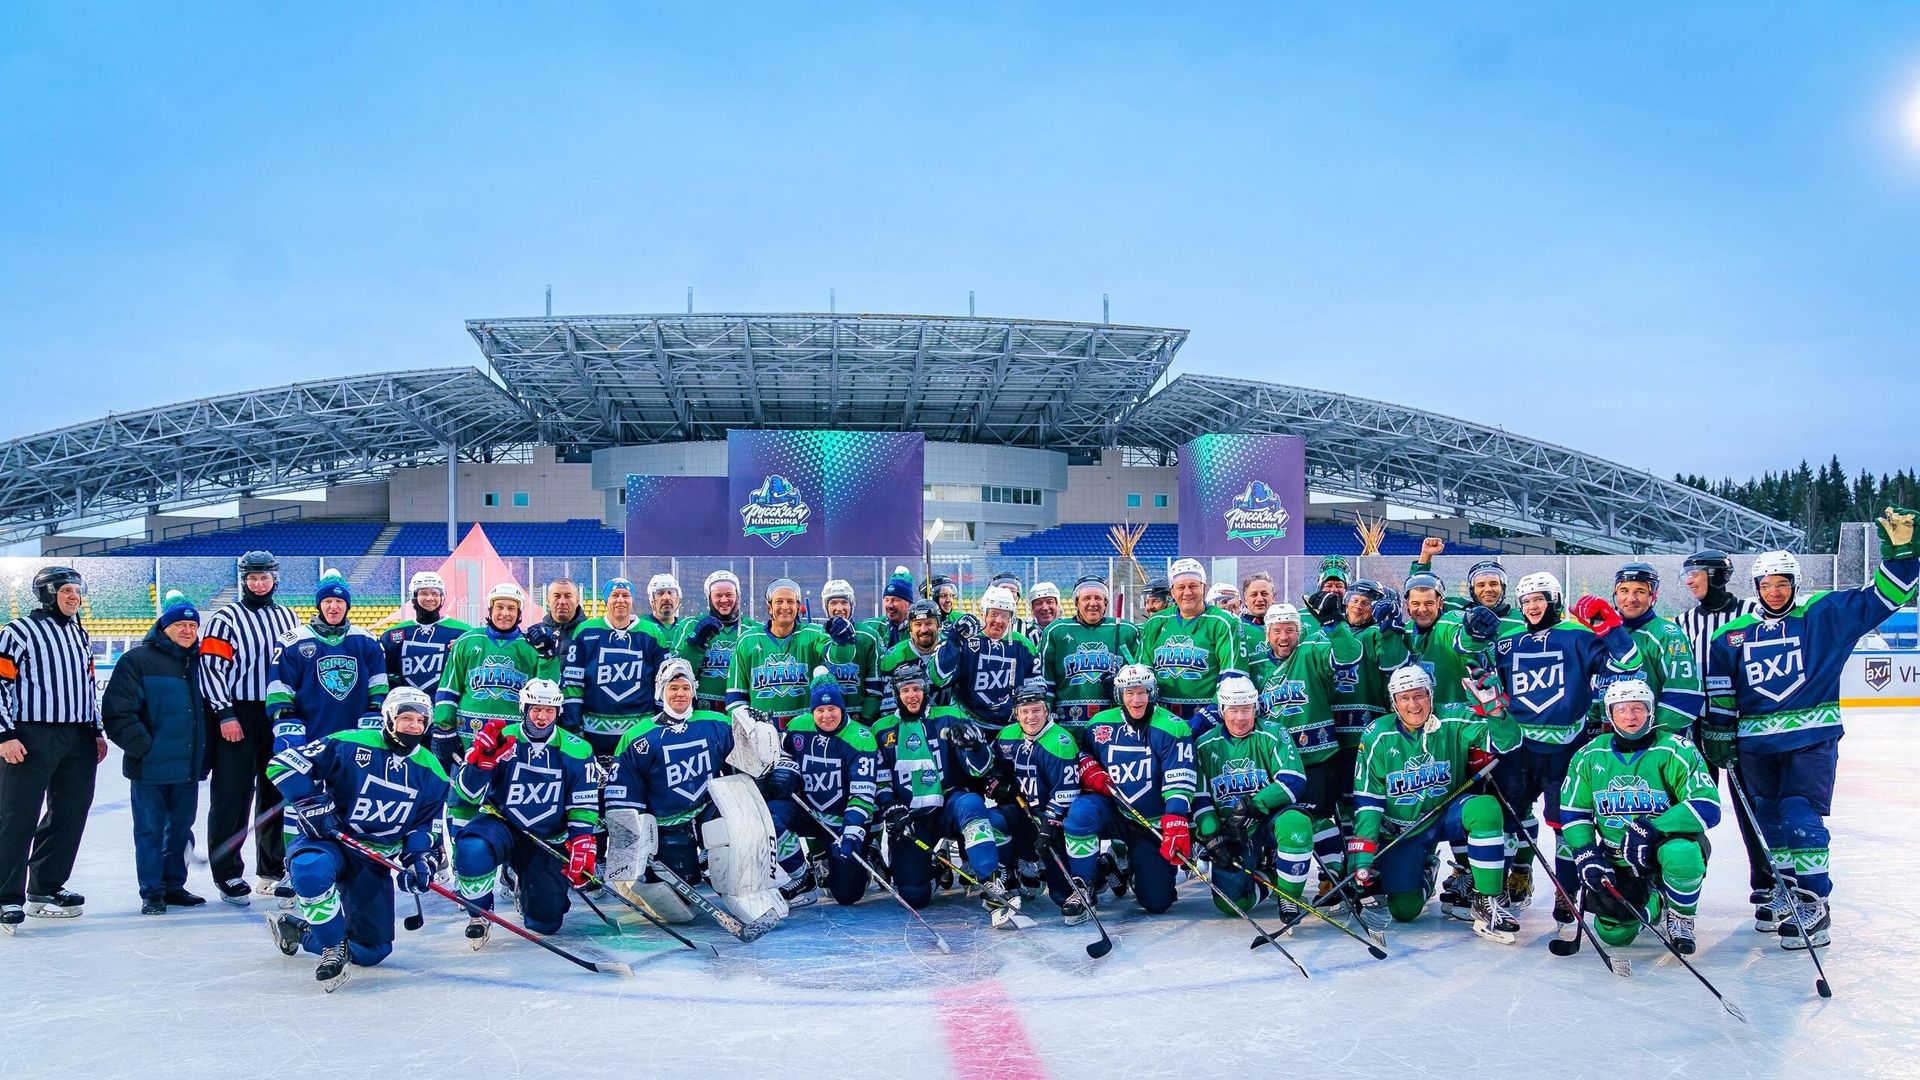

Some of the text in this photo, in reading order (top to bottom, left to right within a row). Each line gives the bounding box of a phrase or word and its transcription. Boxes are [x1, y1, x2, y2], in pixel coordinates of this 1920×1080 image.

[566, 645, 576, 662] 8
[1153, 648, 1208, 671] ГЛАВК
[401, 654, 444, 676] ВХЛ
[597, 660, 643, 685] ВХЛ
[1033, 659, 1041, 674] 2
[1671, 660, 1692, 679] 13
[1746, 649, 1803, 686] ВХЛ
[1866, 664, 1890, 681] ВХЛ
[468, 666, 528, 692] ГЛАВК
[751, 664, 809, 689] ГЛАВК
[974, 669, 1012, 691] ВХЛ
[1512, 664, 1564, 696] ВХЛ
[279, 724, 303, 734] STX
[361, 719, 384, 727] STX
[355, 753, 372, 762] ВХЛ
[1176, 742, 1194, 763] 14
[666, 751, 712, 788] ВХЛ
[857, 756, 875, 776] 31
[1063, 765, 1080, 784] 25
[1108, 759, 1152, 784] ВХЛ
[803, 771, 843, 793] ВХЛ
[1016, 777, 1038, 796] ХЛ
[1388, 761, 1451, 797] ГЛАВК
[506, 781, 562, 806] ВХЛ
[1594, 790, 1669, 815] ГЛАВК
[350, 799, 415, 824] ВХЛ
[1166, 820, 1189, 829] BAU
[608, 864, 629, 879] CCM
